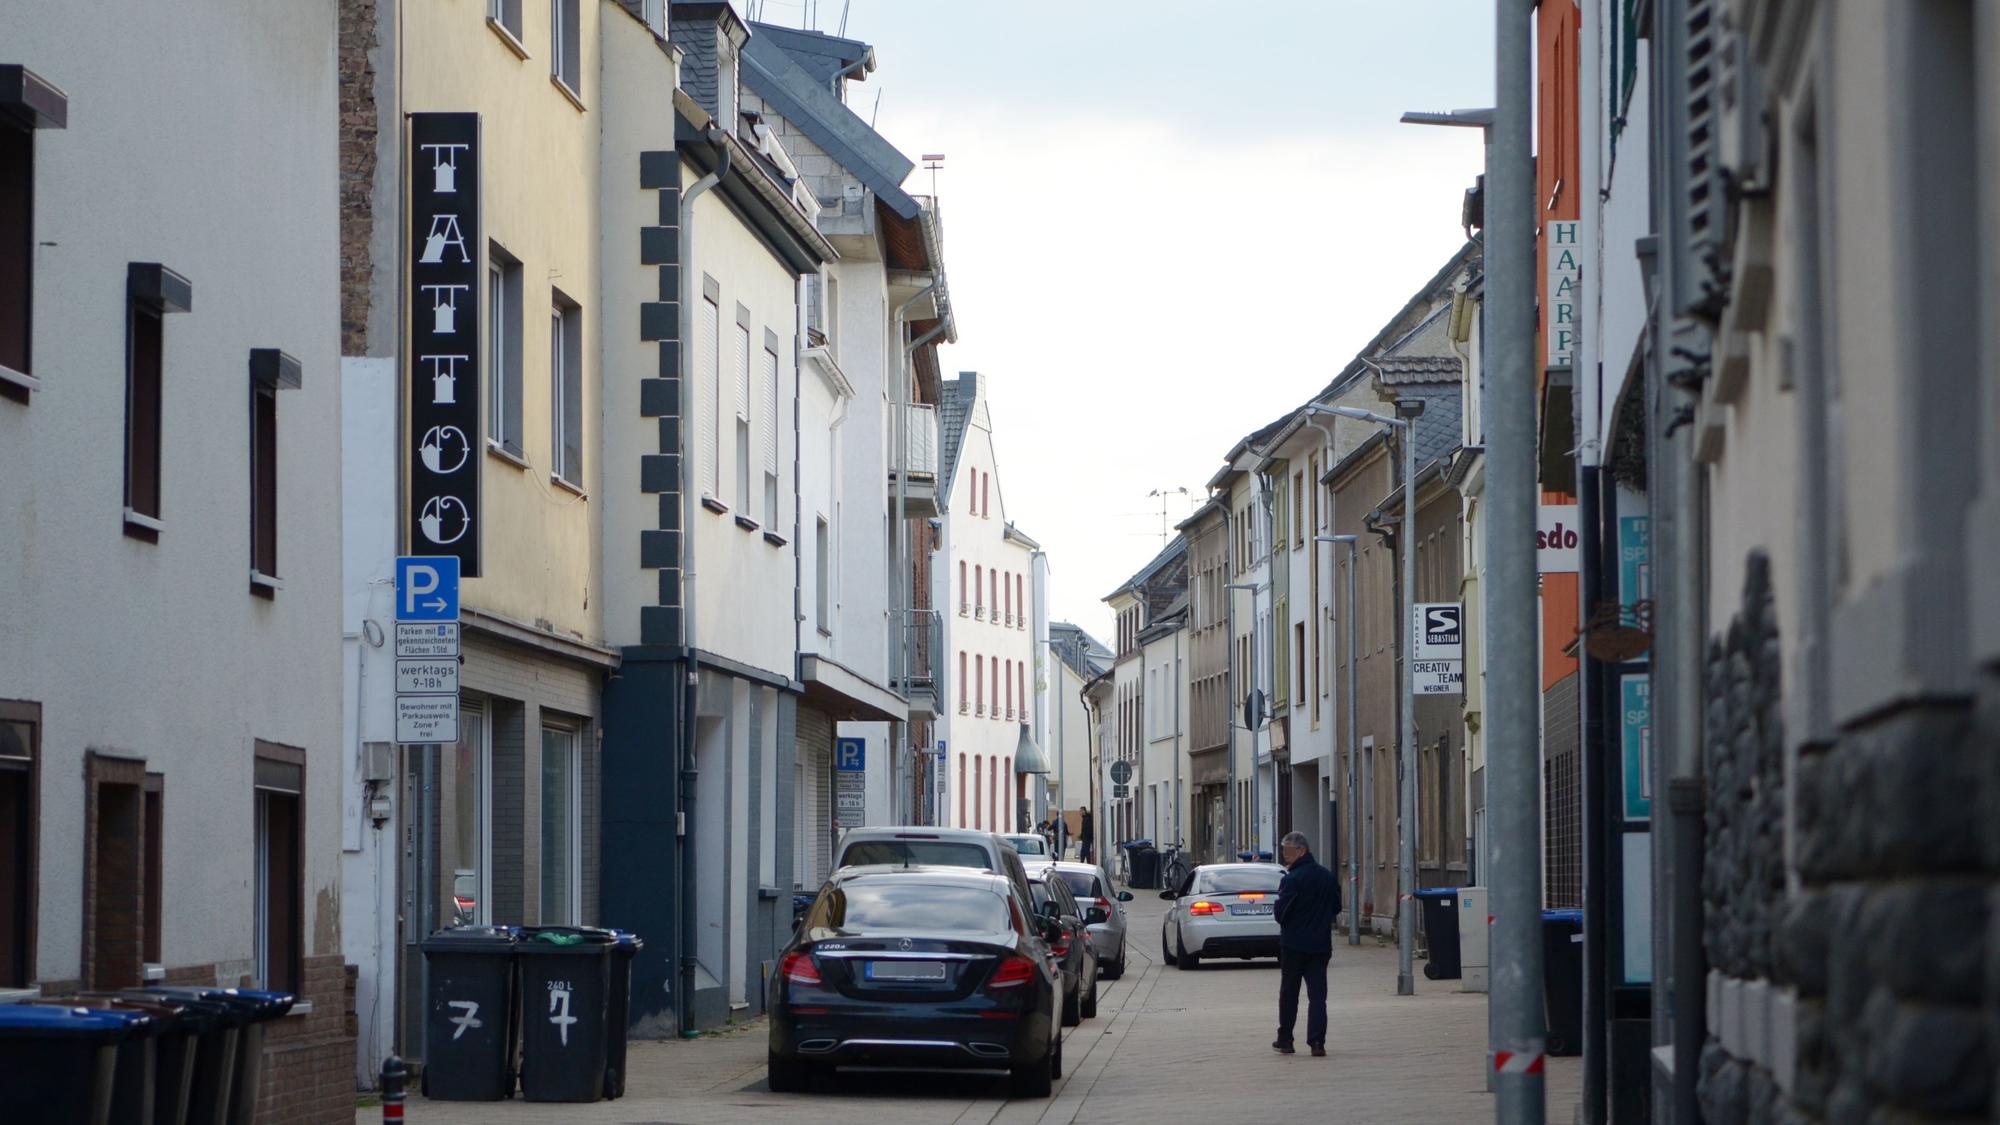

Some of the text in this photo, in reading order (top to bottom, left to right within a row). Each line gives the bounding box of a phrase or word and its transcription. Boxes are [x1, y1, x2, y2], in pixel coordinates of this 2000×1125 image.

[419, 144, 471, 545] TATTOO
[406, 565, 439, 613] P
[401, 627, 422, 635] Parken
[398, 636, 456, 646] gekennzeichneten
[1428, 634, 1458, 643] SEBASTIAN
[405, 646, 430, 654] Flächen
[401, 665, 455, 677] werktags
[1414, 663, 1450, 673] CREATIV
[413, 678, 442, 688] 9-18 h
[1437, 673, 1463, 683] TEAM
[842, 742, 858, 767] P
[448, 1001, 482, 1040] 7
